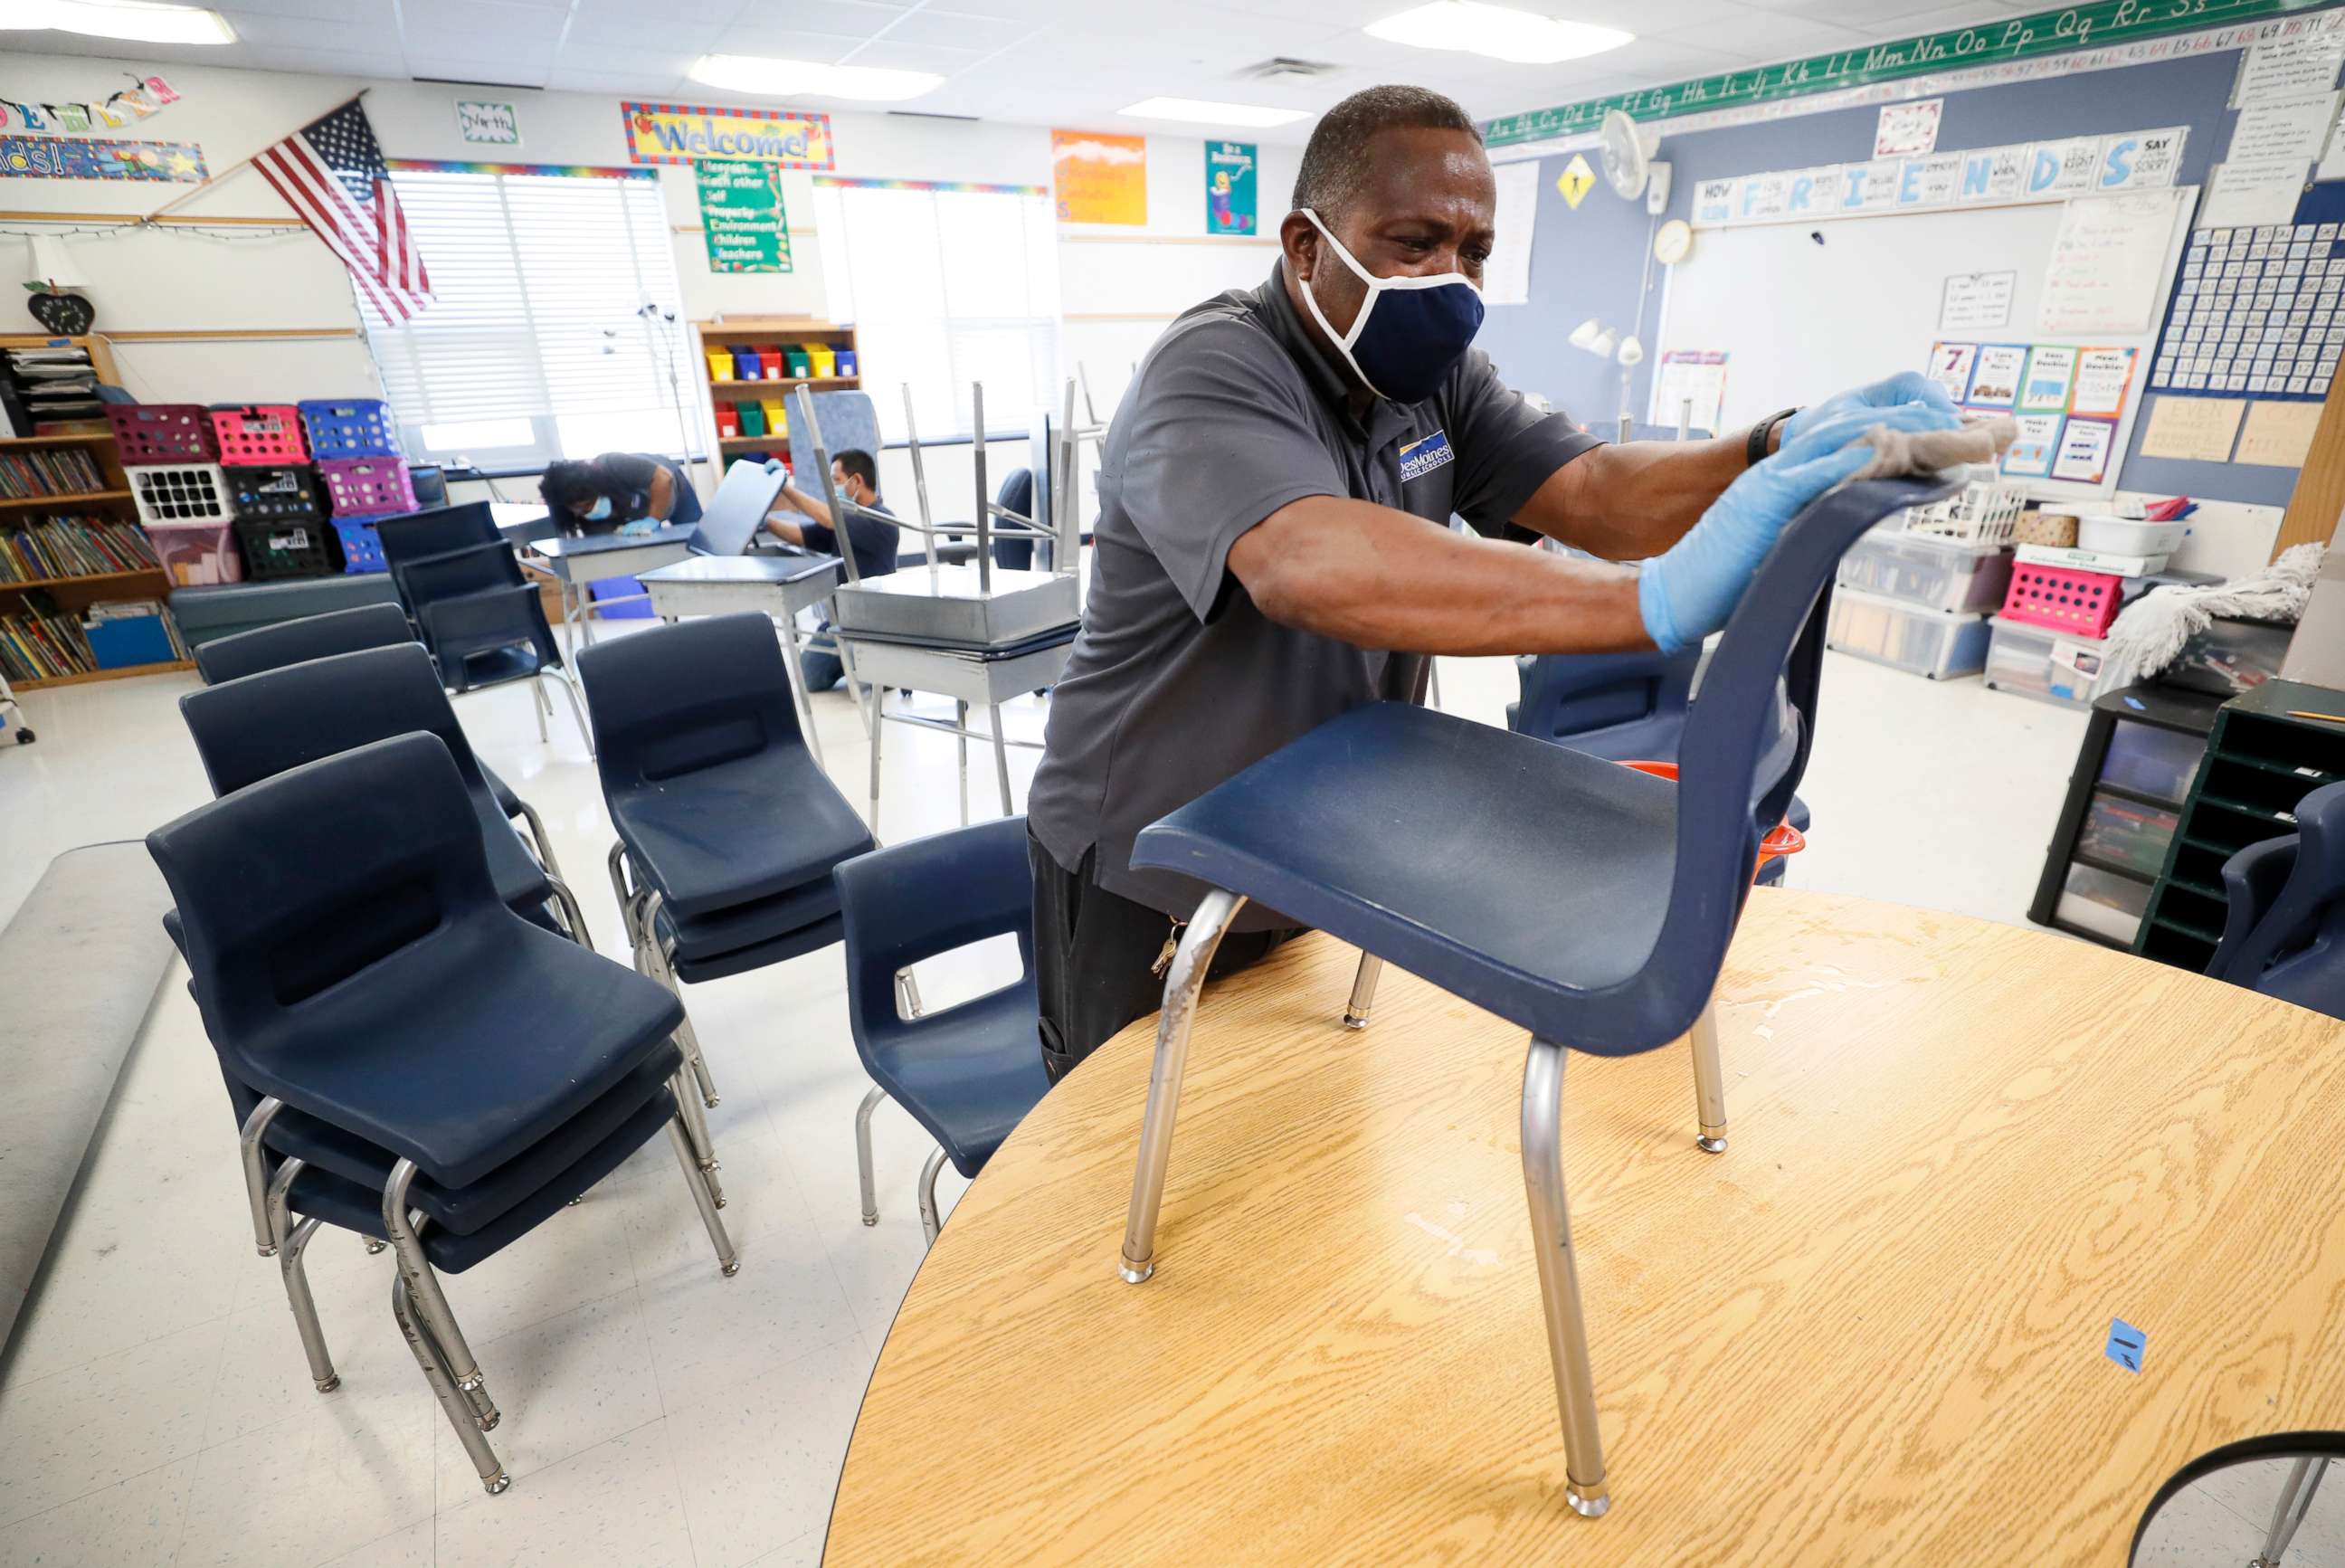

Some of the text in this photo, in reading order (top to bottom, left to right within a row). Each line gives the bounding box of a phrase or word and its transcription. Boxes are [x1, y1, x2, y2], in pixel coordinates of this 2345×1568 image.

[2055, 60, 2069, 71] 59
[2090, 53, 2103, 65] 61
[2128, 45, 2145, 59] 63
[2150, 43, 2168, 56] 64
[2173, 40, 2189, 53] 65
[2193, 36, 2212, 51] 66
[2216, 31, 2235, 47] 67
[2236, 28, 2255, 43] 68
[2261, 24, 2280, 39] 69
[2283, 21, 2302, 36] 70
[2307, 18, 2321, 33] 71
[1491, 120, 1509, 137] Aa
[1515, 115, 1533, 134] Bb
[1540, 110, 1558, 128] Cc
[1562, 106, 1584, 124] Dd
[1621, 93, 1644, 111] Ff
[1650, 89, 1672, 116] Gg
[1681, 81, 1708, 103] Hh
[1720, 74, 1738, 97] Ii
[1749, 70, 1768, 100] Jj
[1780, 61, 1809, 86] Kk
[1825, 52, 1853, 78] Ll
[1863, 46, 1904, 71] Mm
[1911, 37, 1947, 62] Nn
[1954, 29, 1987, 55] Oo
[2000, 20, 2034, 56] Pp
[2055, 9, 2093, 44] Qq
[2111, 0, 2150, 28] Rr
[653, 119, 809, 158] Welcome!
[2144, 138, 2171, 151] SAY
[2134, 158, 2169, 174] SORRY
[702, 175, 764, 188] Each other
[1704, 182, 1732, 199] HOW
[707, 204, 755, 220] Property
[709, 219, 778, 233] Environment
[712, 233, 757, 245] Children
[715, 247, 764, 259] Teachers
[2299, 347, 2315, 357] 27
[1945, 349, 1964, 371] 7
[2215, 362, 2227, 371] 13
[2235, 362, 2246, 371] 14
[2276, 363, 2290, 373] 16
[2297, 364, 2312, 373] 17
[2318, 364, 2332, 374] 18
[2192, 376, 2200, 385] 2
[2215, 377, 2222, 385] 3
[2233, 377, 2239, 386] 4
[2273, 379, 2279, 388] 6
[2293, 379, 2301, 389] 7
[2314, 380, 2322, 390] 8
[2171, 402, 2224, 418] EVEN
